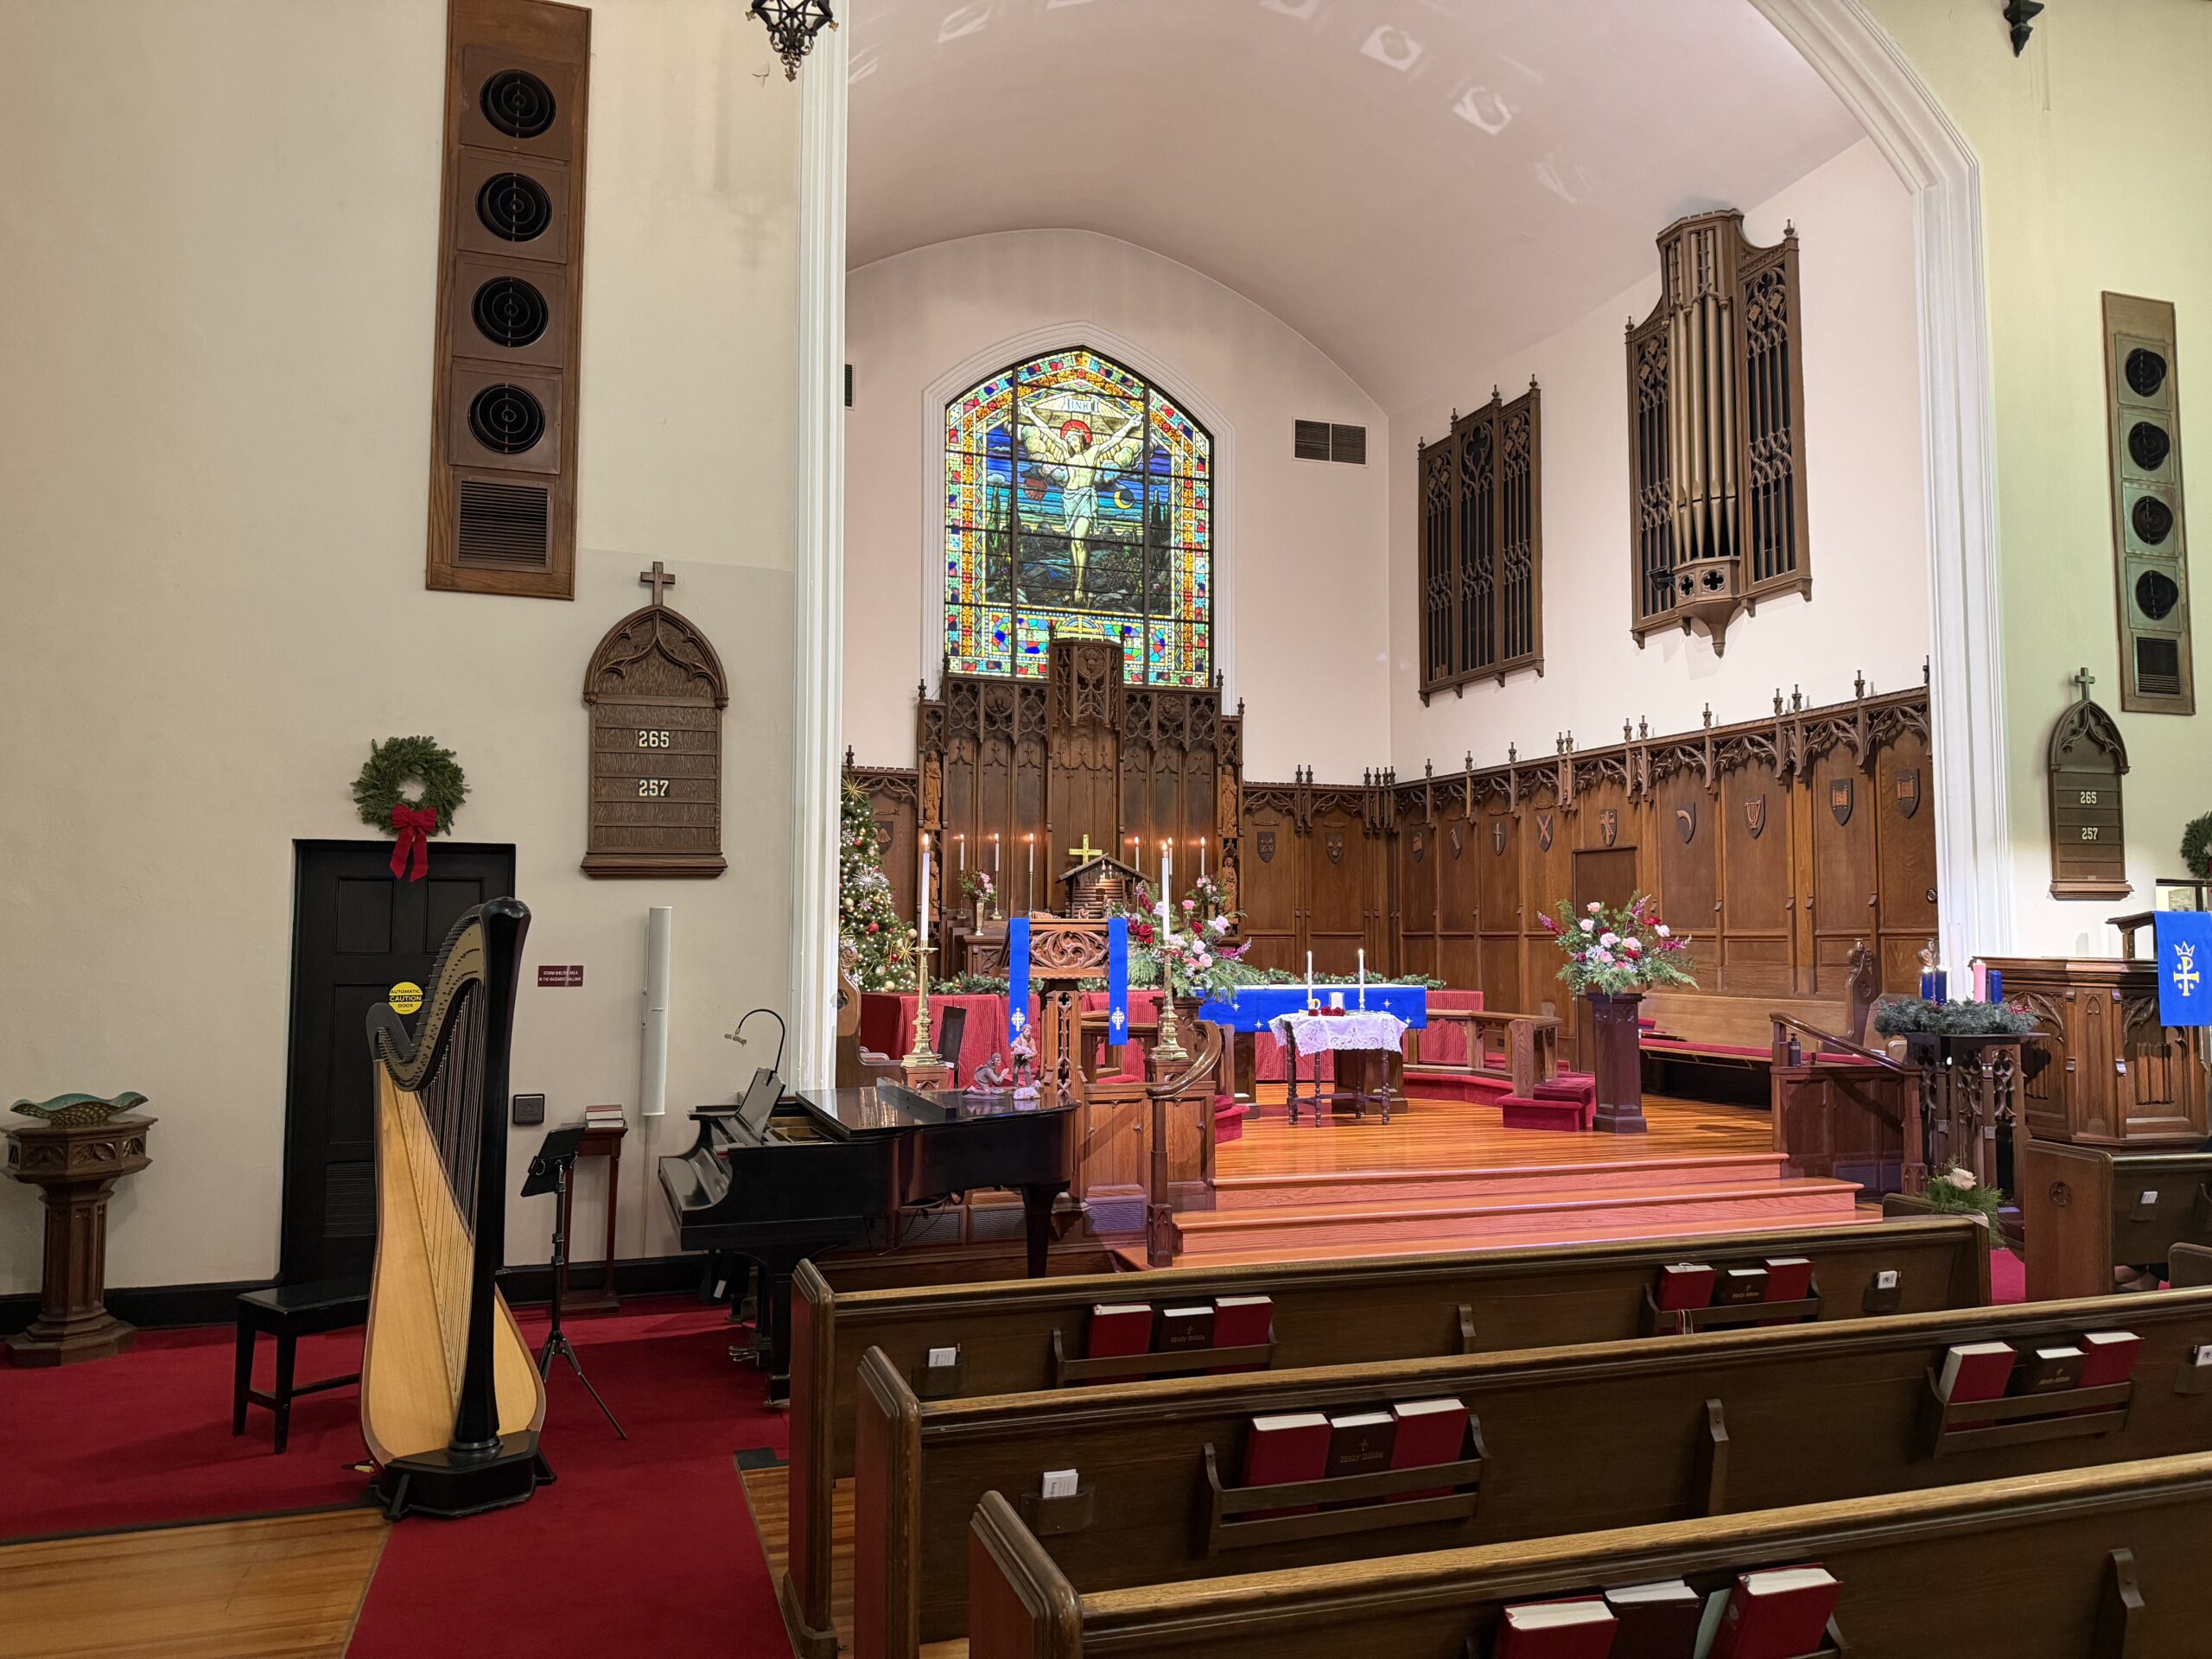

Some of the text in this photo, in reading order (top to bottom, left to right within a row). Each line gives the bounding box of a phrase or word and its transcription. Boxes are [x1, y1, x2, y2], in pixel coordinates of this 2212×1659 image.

[1071, 400, 1093, 412] INRI
[639, 730, 670, 748] 265
[639, 779, 670, 797] 257
[2080, 791, 2097, 804] 265
[2082, 827, 2098, 840] 257
